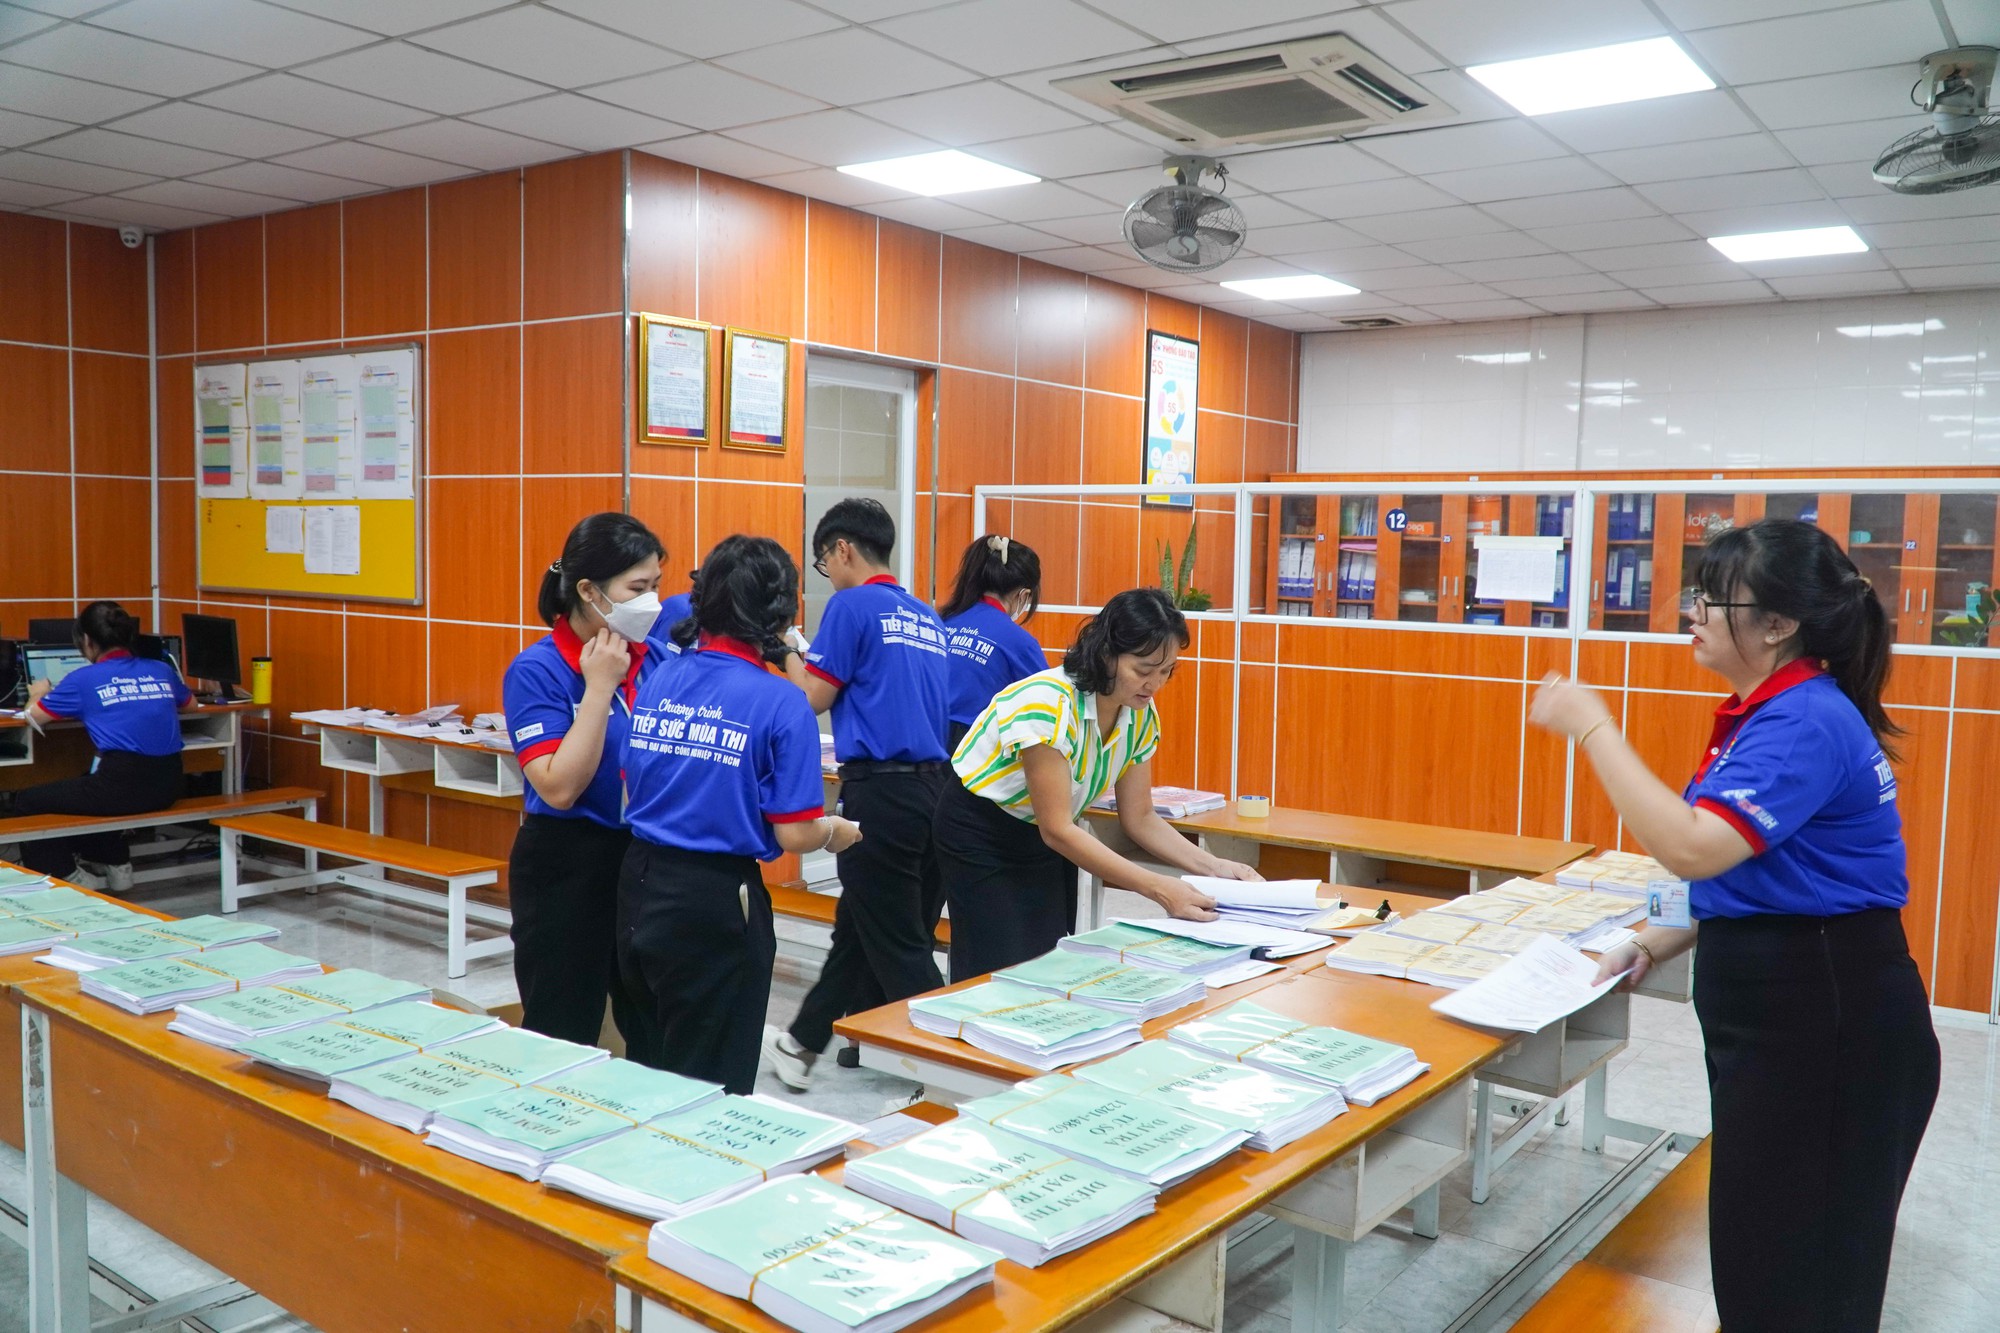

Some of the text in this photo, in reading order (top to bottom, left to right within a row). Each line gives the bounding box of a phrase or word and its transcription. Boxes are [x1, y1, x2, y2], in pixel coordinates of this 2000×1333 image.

[1151, 359, 1164, 375] 5S
[1167, 402, 1177, 414] 5S
[1388, 512, 1406, 529] 12
[950, 634, 974, 648] MÙA
[974, 640, 995, 657] THI
[658, 698, 723, 721] Chương trình
[632, 710, 748, 752] TIẾP SỨC MÙA THI
[721, 755, 741, 768] HCM
[276, 1040, 305, 1049] THI
[378, 1072, 407, 1083] THI
[483, 1107, 516, 1120] THI
[1048, 1100, 1127, 1133] 12201-14862
[773, 1125, 806, 1137] THI
[1125, 1142, 1159, 1157] THI
[1024, 1205, 1062, 1221] THI
